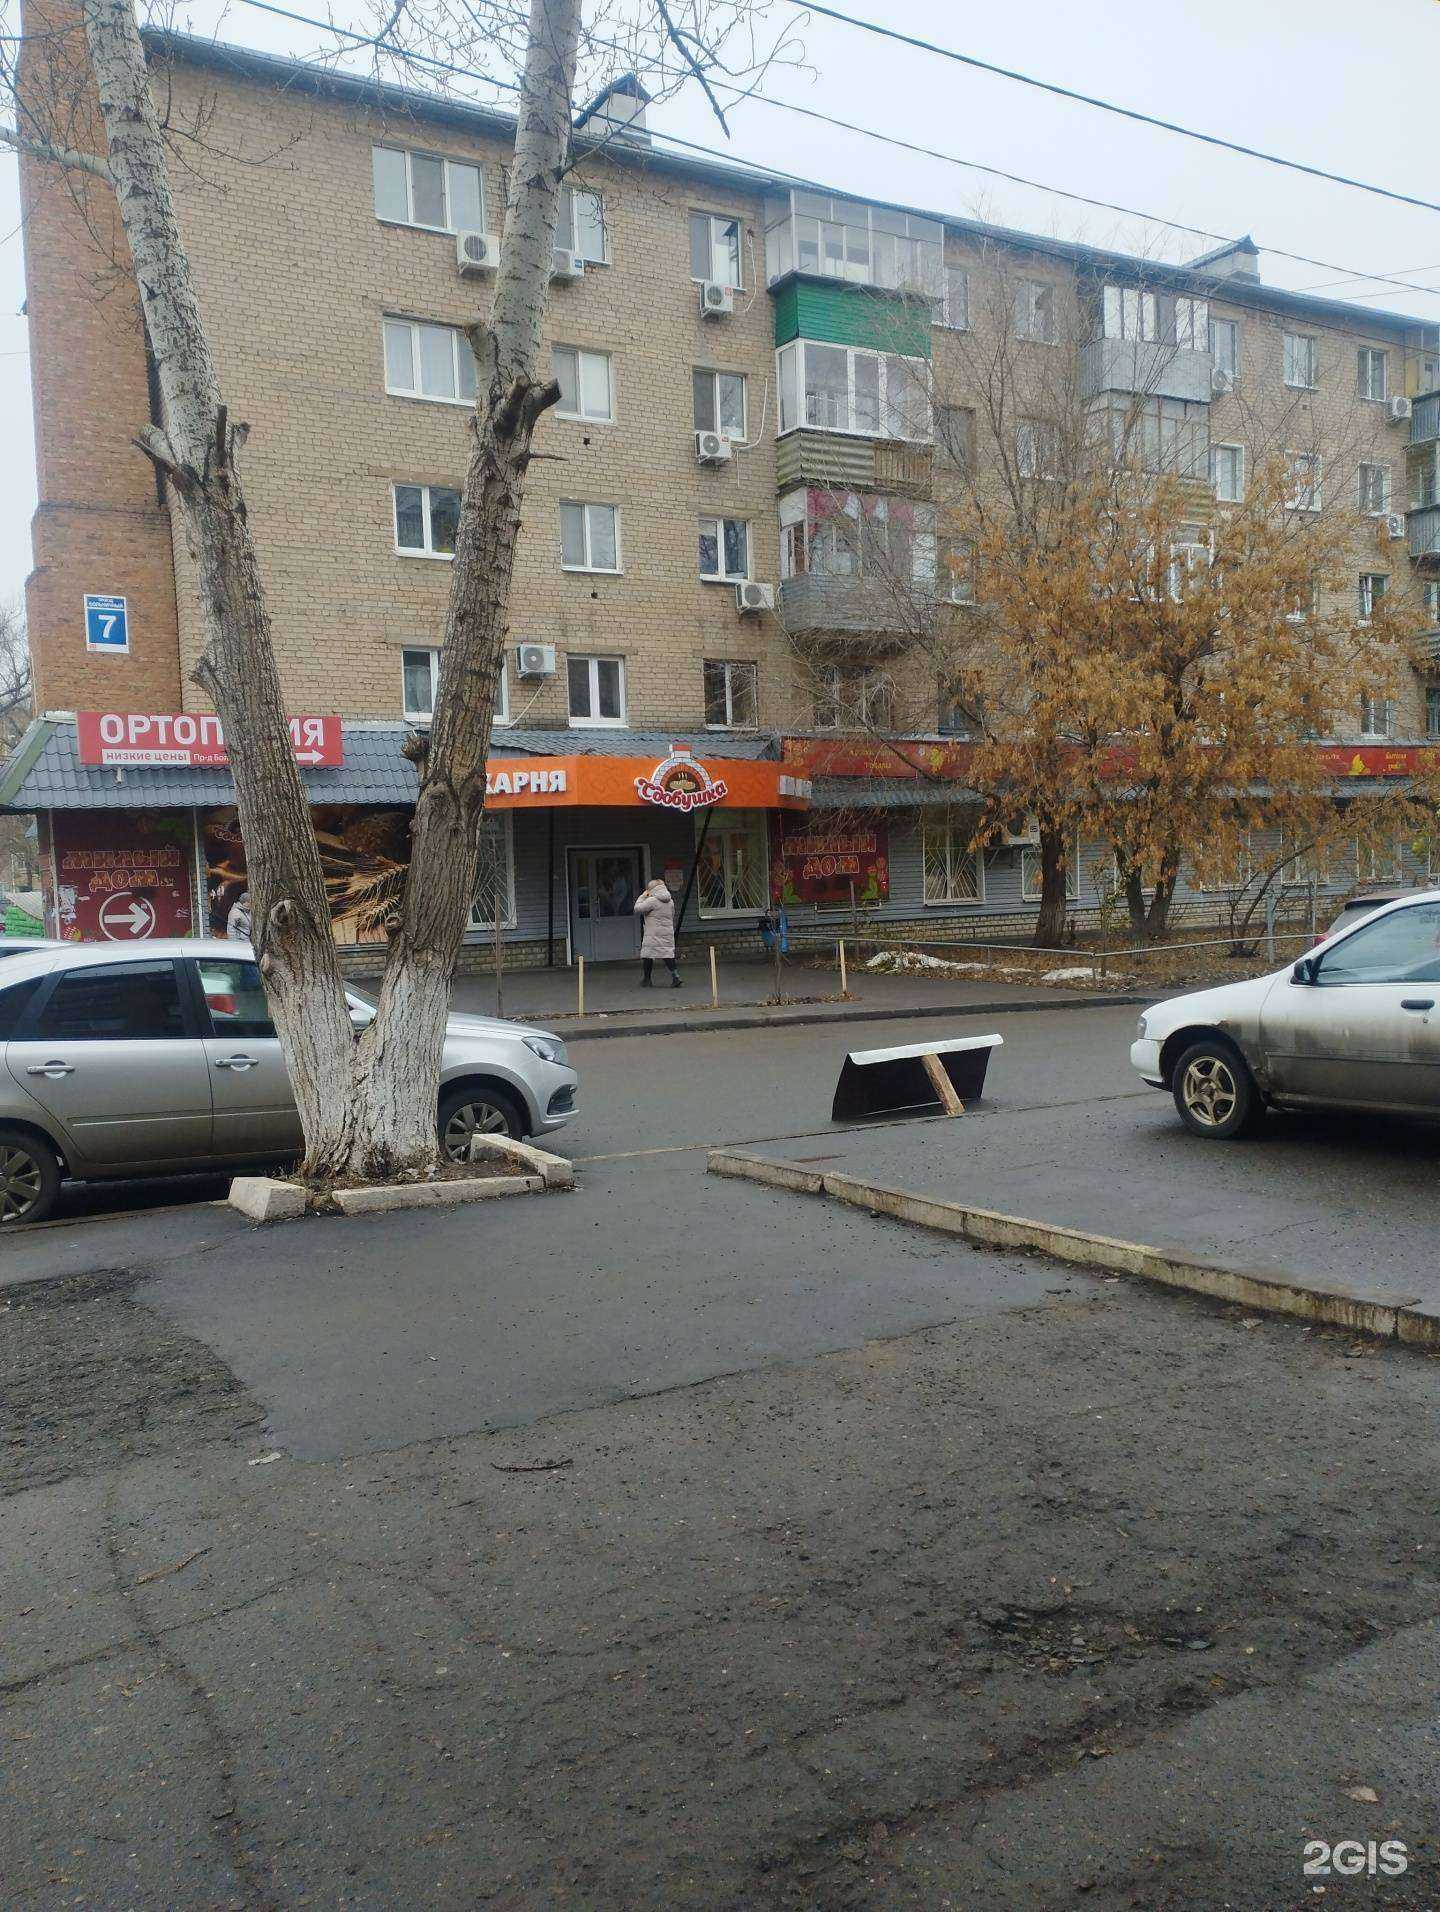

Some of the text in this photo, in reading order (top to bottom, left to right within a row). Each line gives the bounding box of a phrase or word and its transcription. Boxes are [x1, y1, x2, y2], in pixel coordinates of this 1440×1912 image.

[98, 614, 117, 639] 7
[100, 714, 324, 746] ОРТОПИЯ
[106, 751, 150, 761] низкие
[154, 752, 187, 763] цены
[485, 770, 567, 794] КАРНЯ
[635, 777, 728, 811] Сдобушка
[803, 855, 860, 880] ДОМ
[89, 869, 160, 892] ДОМ
